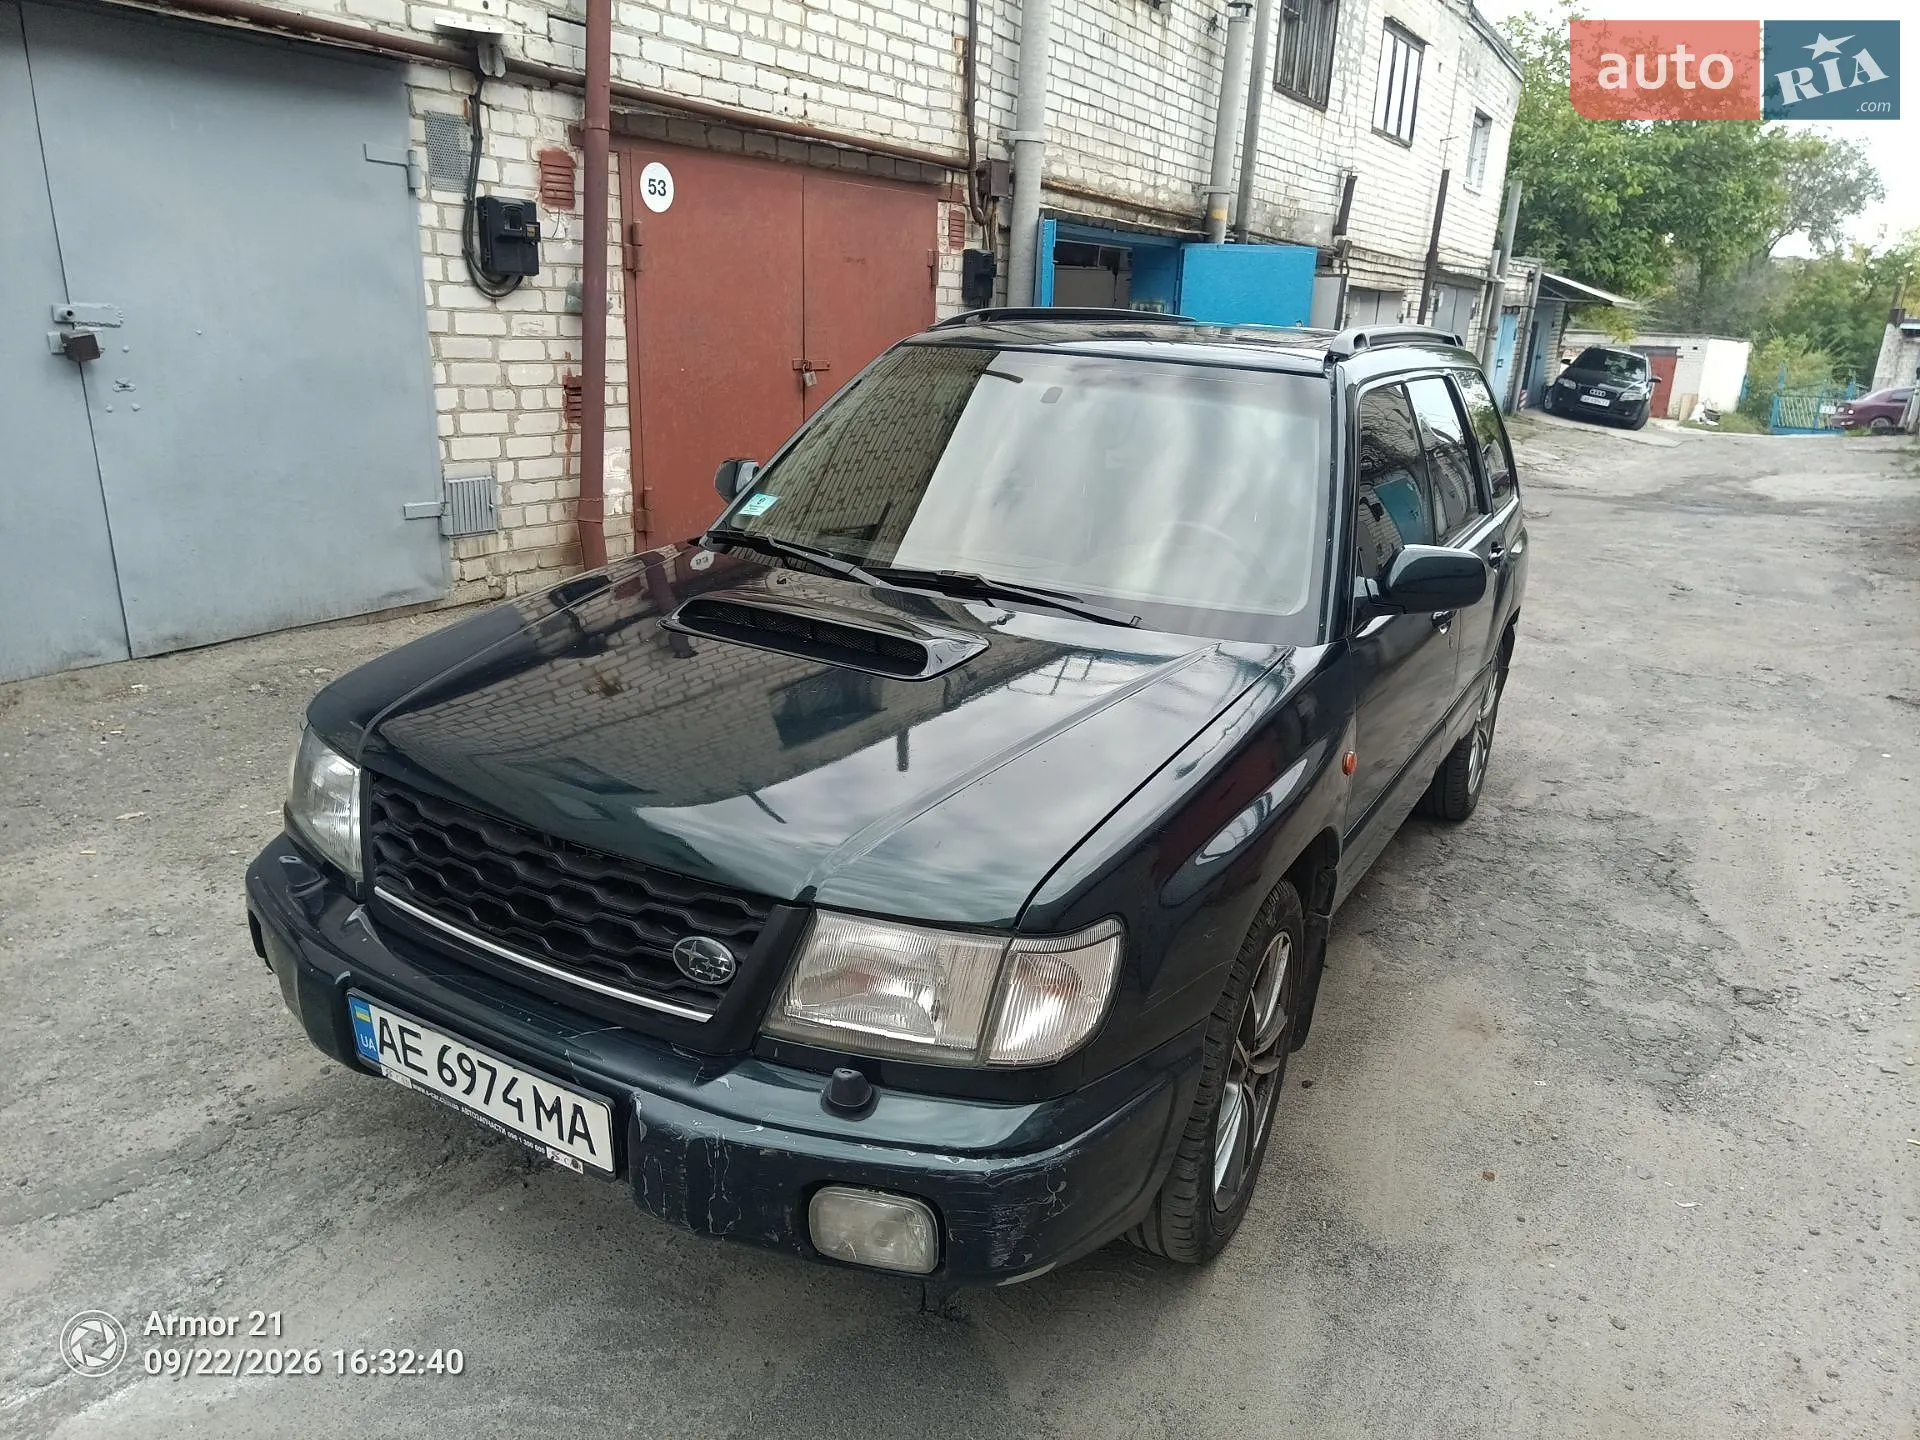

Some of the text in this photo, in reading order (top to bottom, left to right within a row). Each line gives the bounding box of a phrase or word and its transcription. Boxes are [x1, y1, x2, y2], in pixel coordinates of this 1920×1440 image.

[648, 178, 667, 197] 53
[360, 1033, 376, 1052] UA
[379, 1016, 597, 1156] AE 6974 MA
